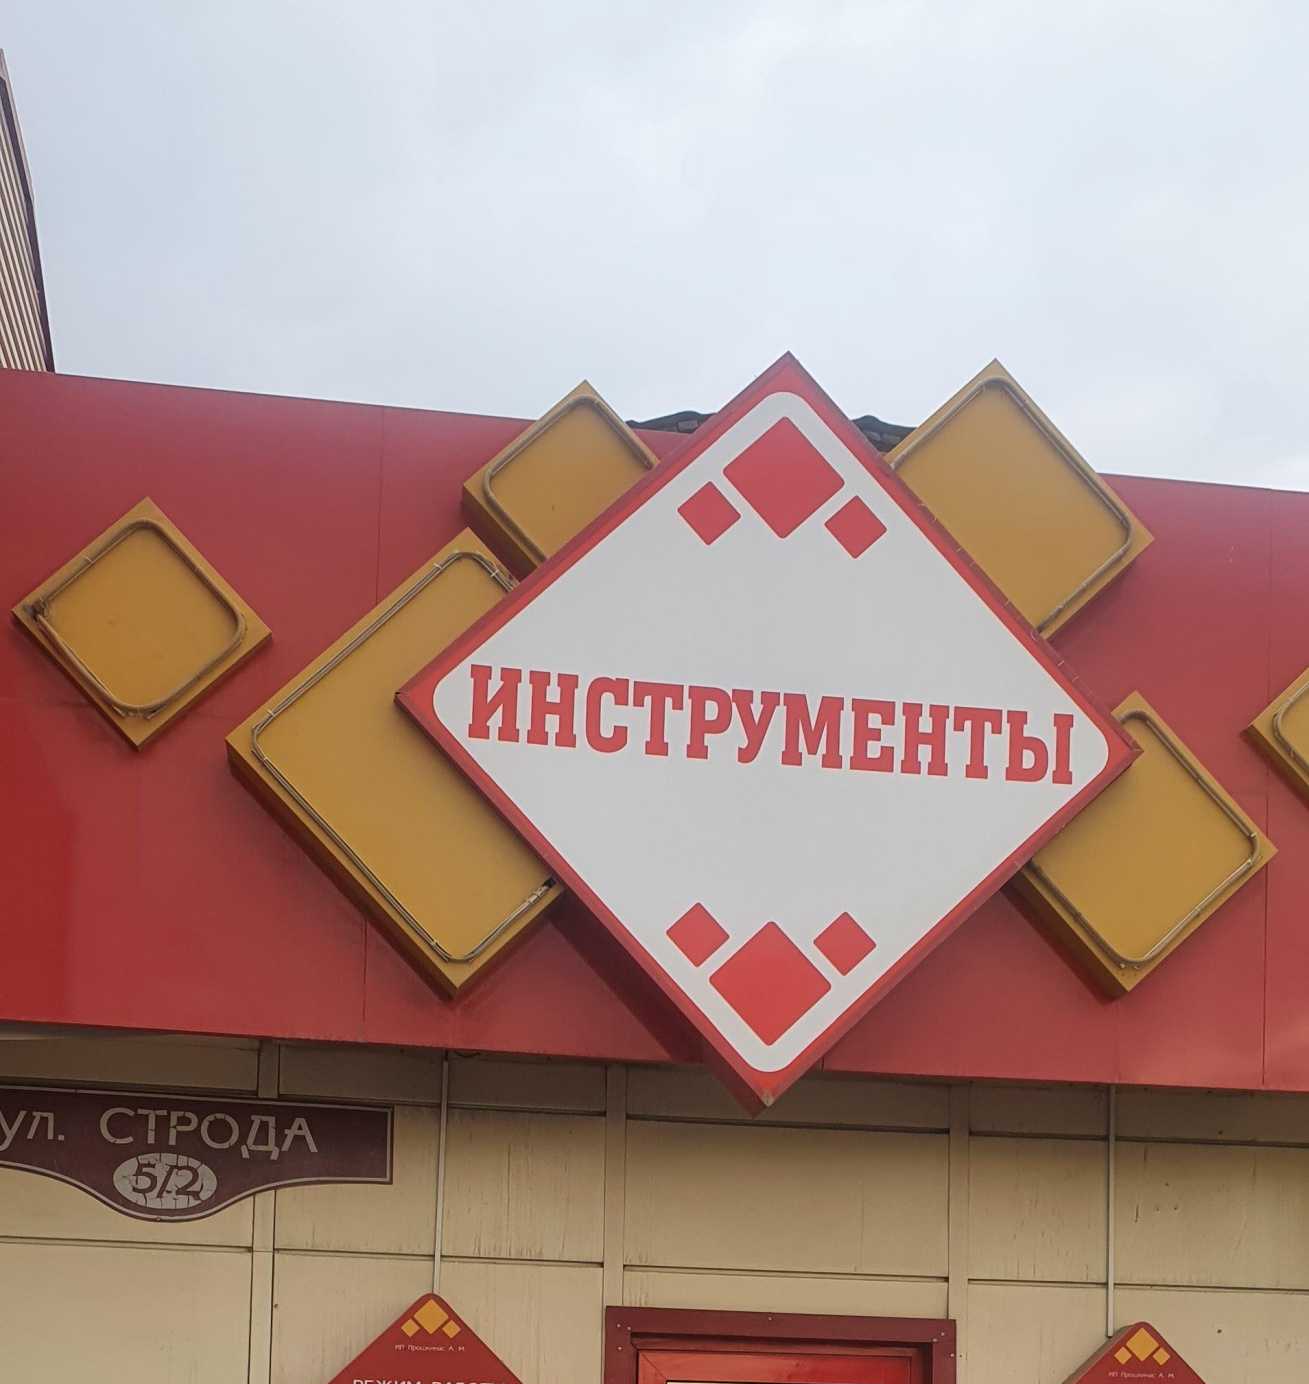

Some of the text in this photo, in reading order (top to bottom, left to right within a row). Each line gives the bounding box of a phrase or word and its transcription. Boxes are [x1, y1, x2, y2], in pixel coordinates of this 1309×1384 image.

[468, 664, 1074, 785] ИНСТРУМЕНТЫ
[0, 1107, 319, 1160] ул. СТРОДА
[132, 1162, 203, 1199] 5/2
